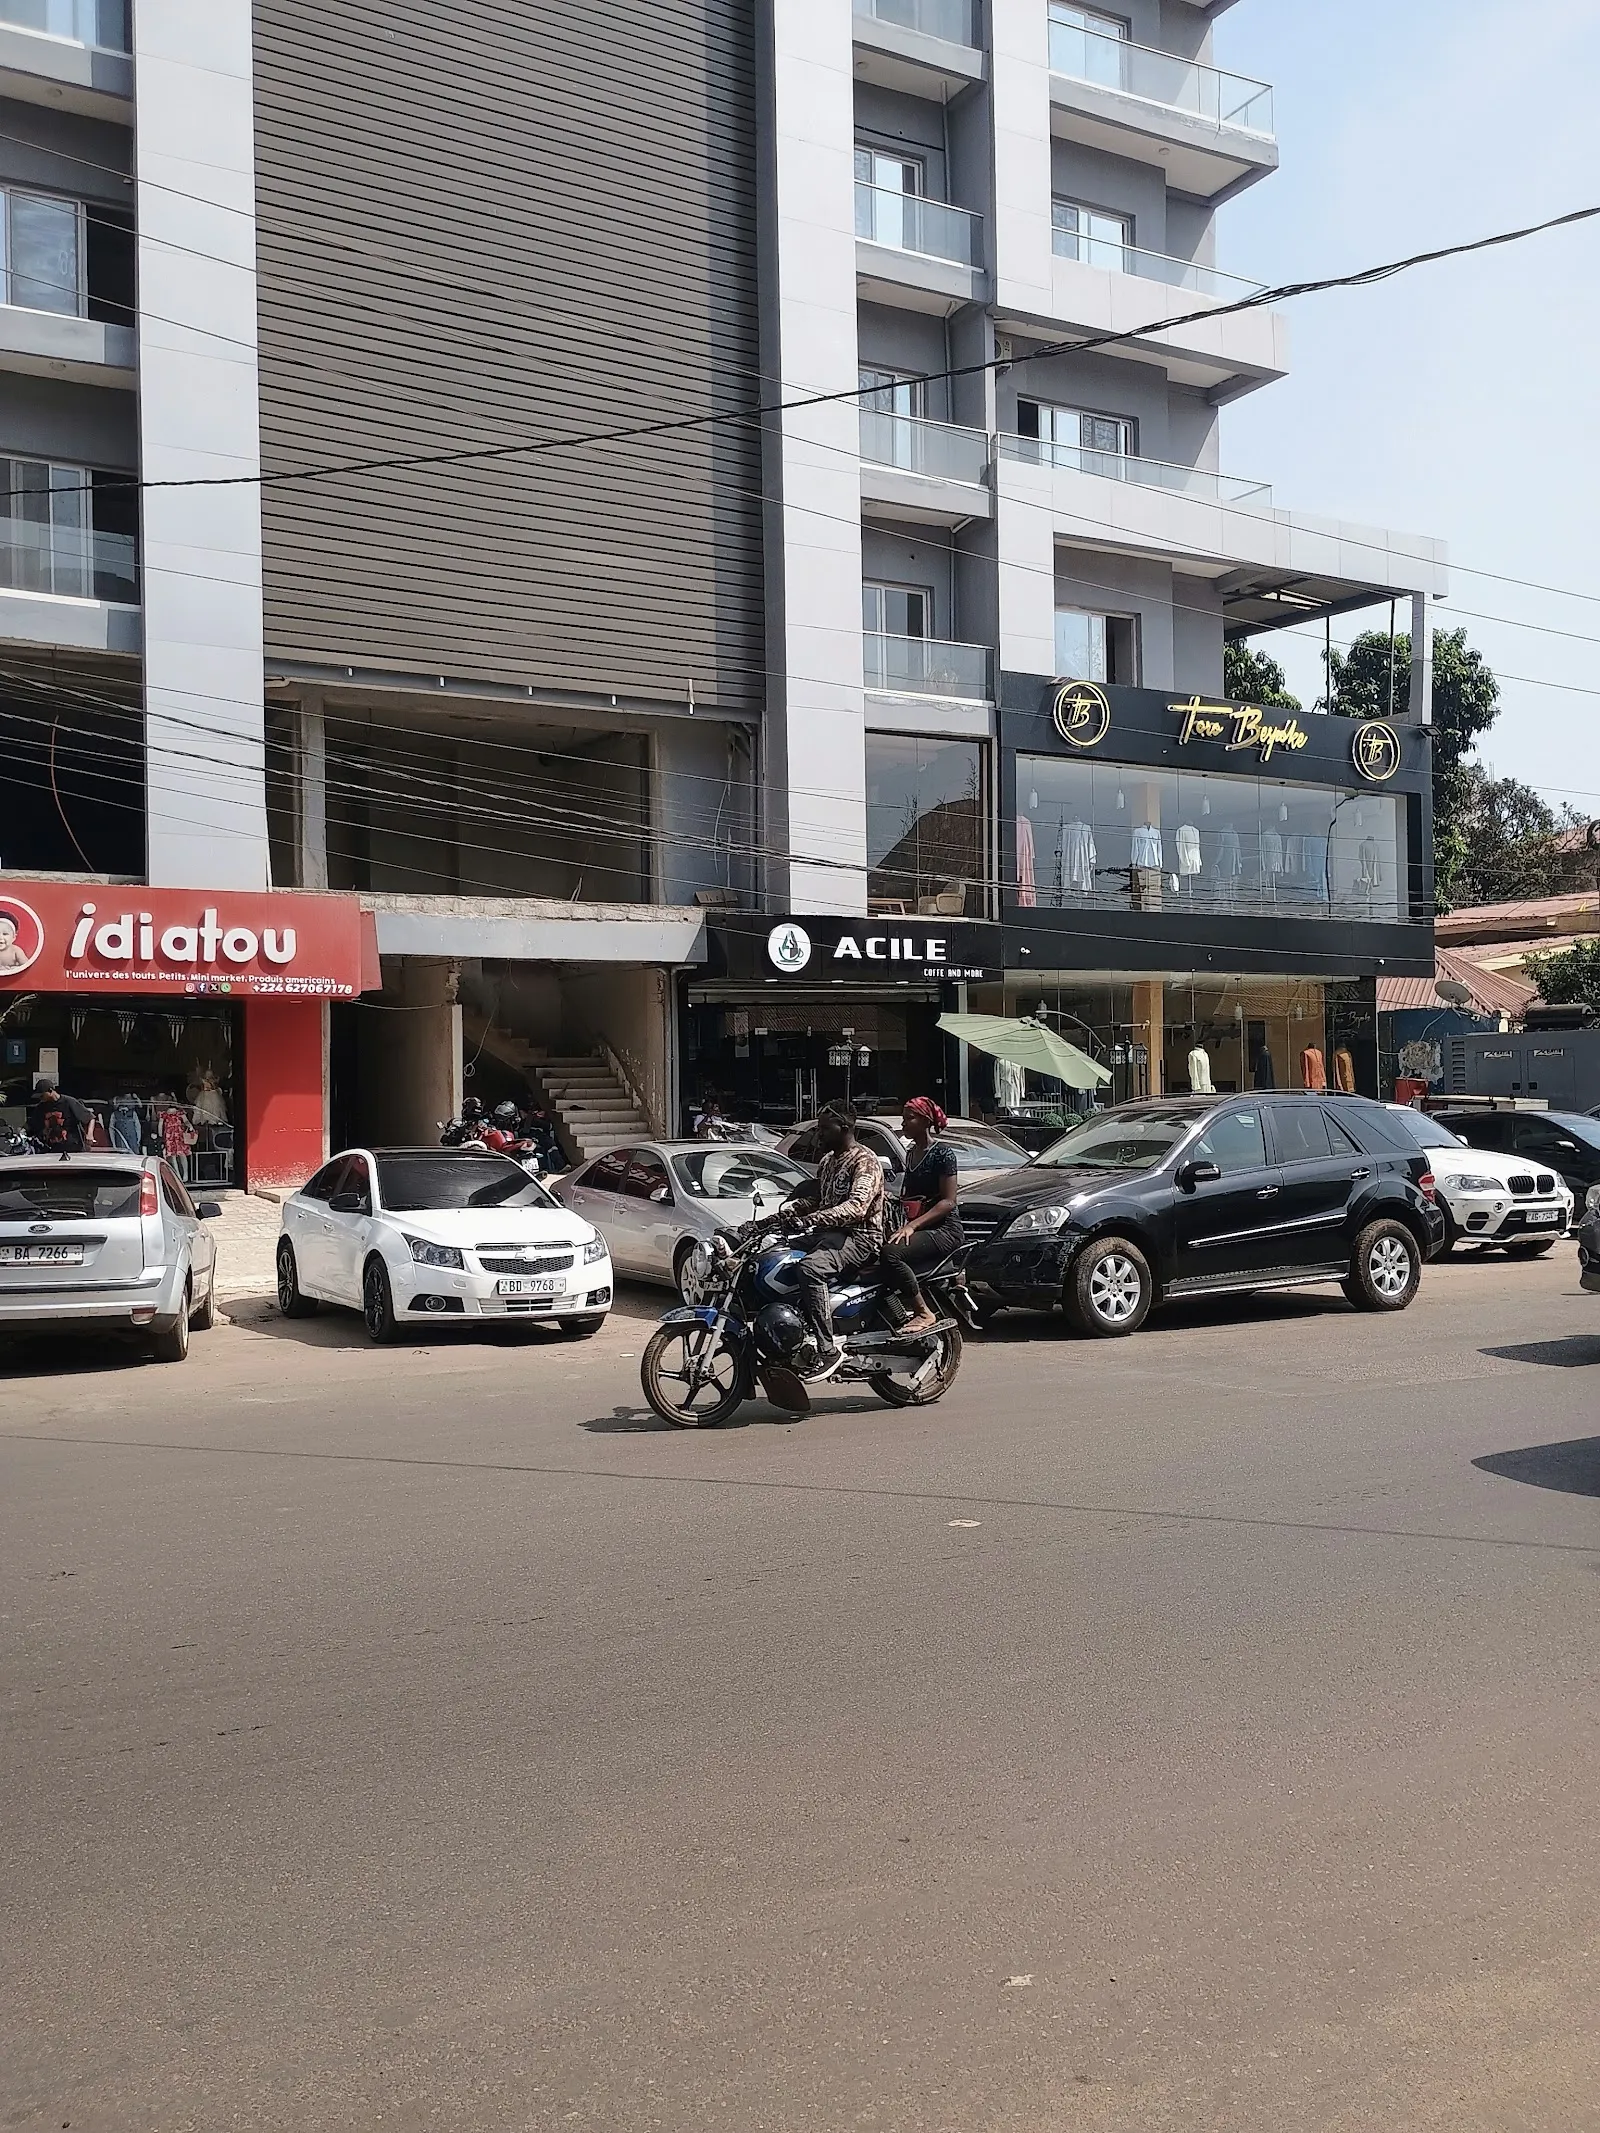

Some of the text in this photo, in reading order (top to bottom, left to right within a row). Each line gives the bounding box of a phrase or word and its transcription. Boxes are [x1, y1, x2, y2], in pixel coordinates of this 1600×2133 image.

[1225, 706, 1308, 762] Bespoke
[70, 902, 297, 964] idiatou
[833, 936, 947, 961] ACILE
[112, 970, 130, 979] des
[131, 970, 156, 980] touts
[923, 968, 984, 978] COFFE AND MORE
[252, 983, 353, 995] +224 627067178
[14, 1247, 30, 1260] BA
[38, 1246, 68, 1259] 7266
[509, 1280, 522, 1292] BD
[530, 1280, 554, 1292] 9768
